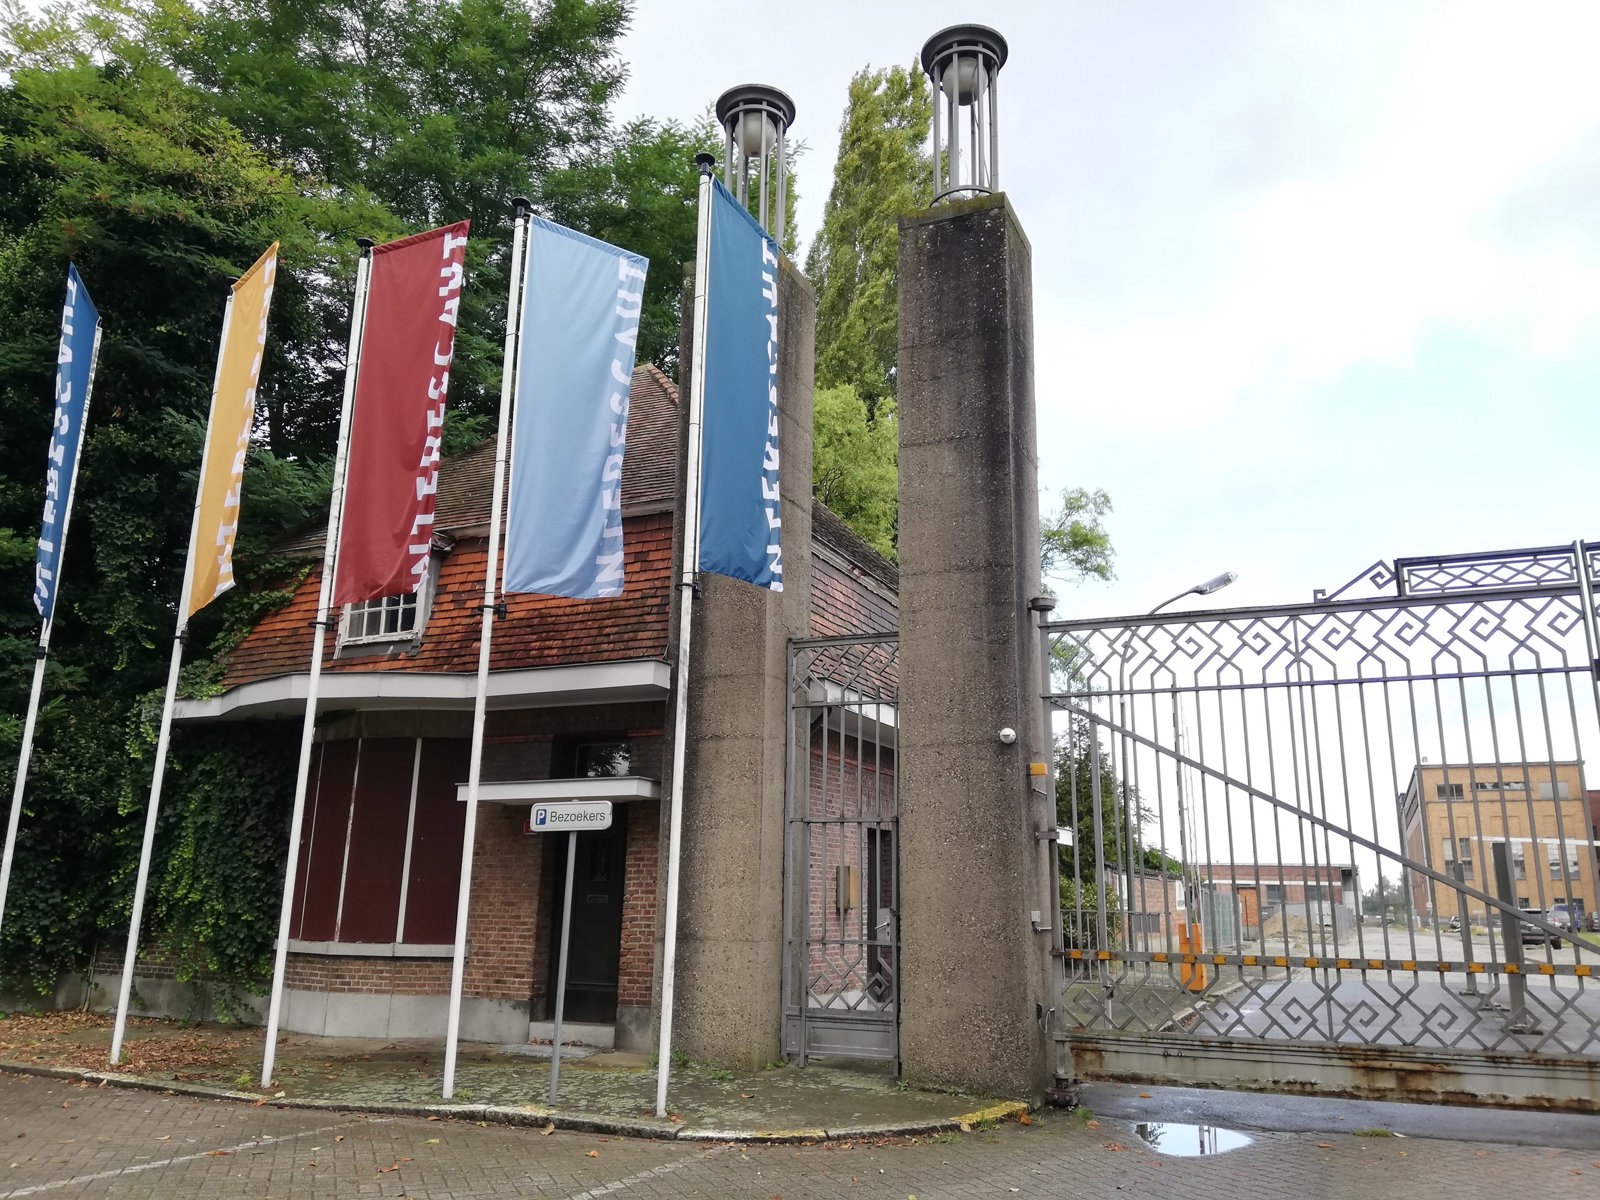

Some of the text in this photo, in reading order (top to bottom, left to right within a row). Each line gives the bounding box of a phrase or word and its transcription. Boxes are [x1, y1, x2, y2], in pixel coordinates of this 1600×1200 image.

[409, 232, 468, 592] INTERESCAUT
[596, 256, 648, 598] INTERESCAUT
[536, 809, 606, 825] P Bezoekers
